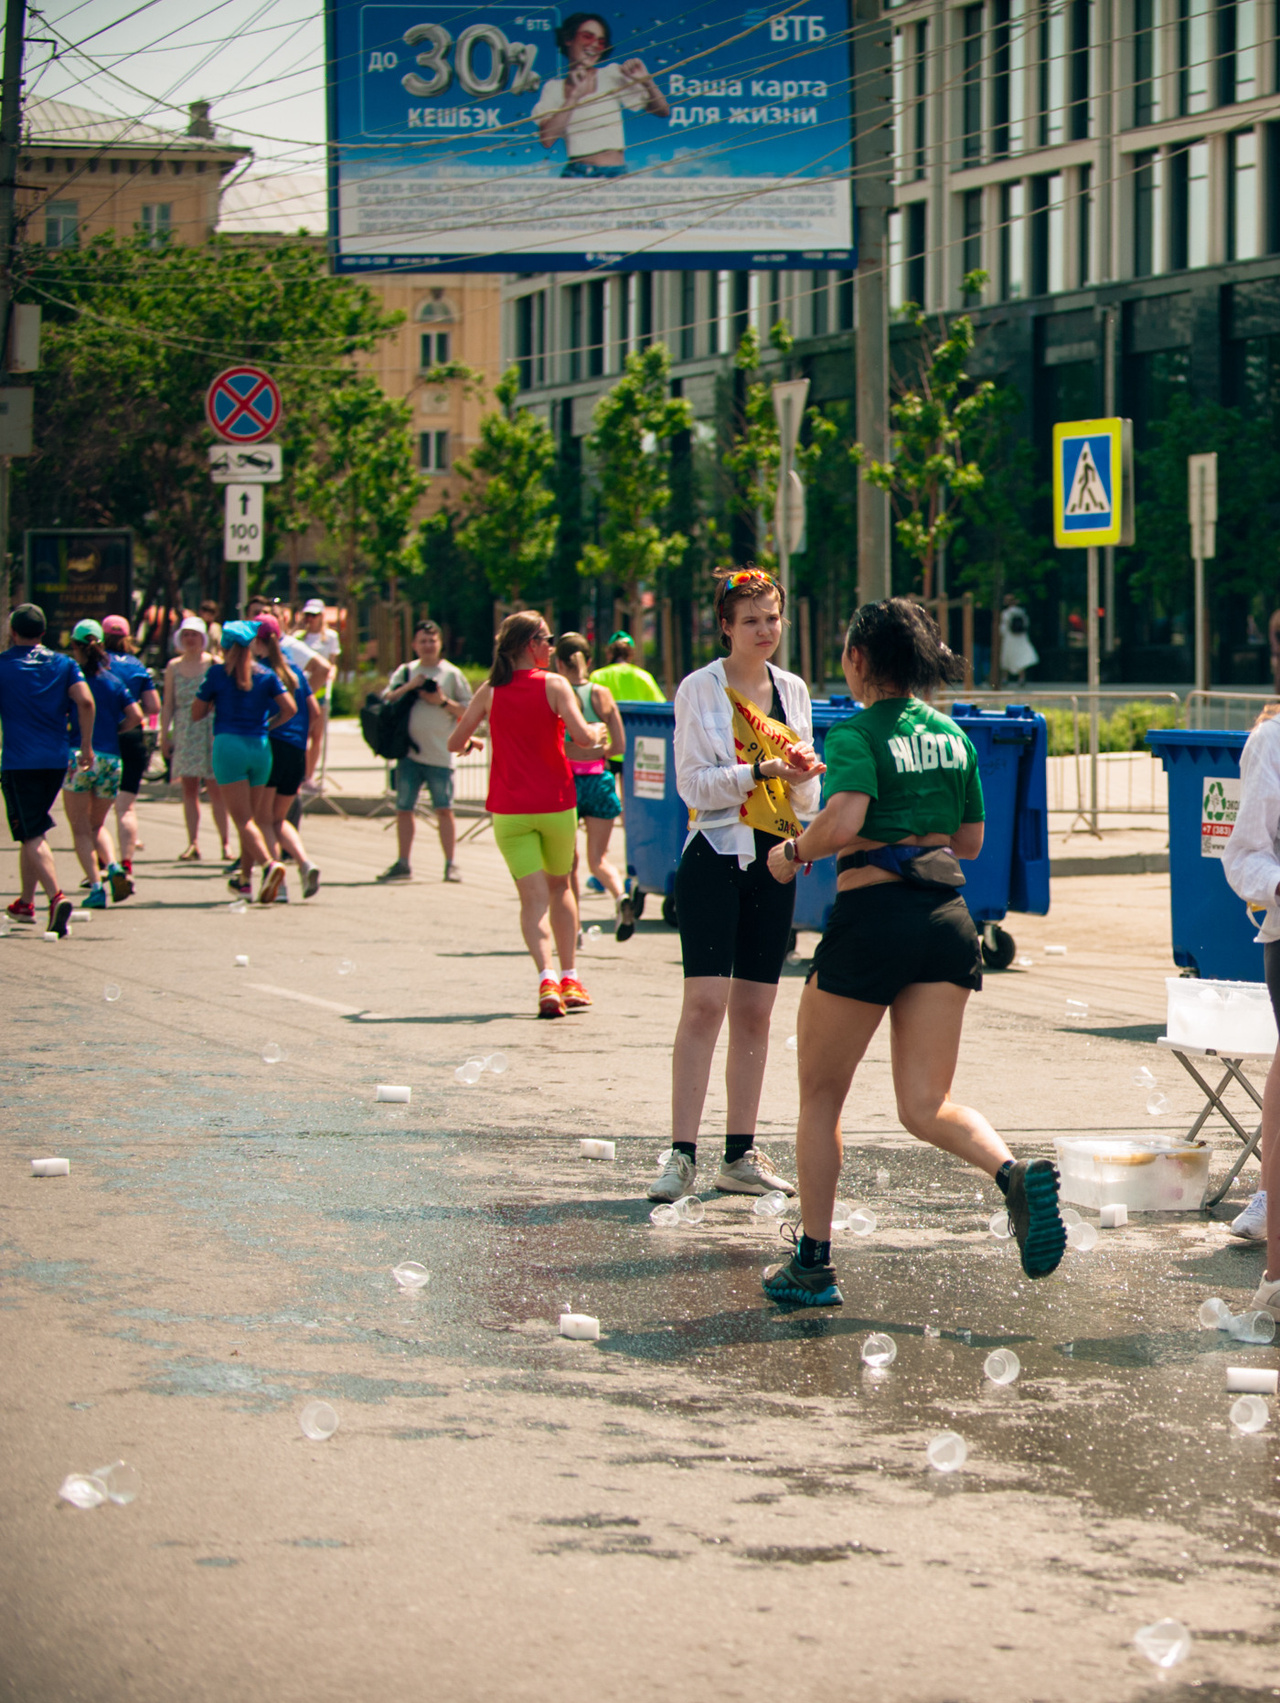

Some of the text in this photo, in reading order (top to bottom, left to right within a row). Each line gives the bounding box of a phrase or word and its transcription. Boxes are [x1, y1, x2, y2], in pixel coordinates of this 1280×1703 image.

[526, 18, 552, 31] ВТБ
[770, 15, 827, 42] ВТБ
[669, 74, 828, 103] Ваша карта
[408, 107, 502, 129] КЕШБЭК
[668, 106, 818, 128] для жизни
[230, 523, 259, 540] 100
[734, 701, 792, 752] ВОЛОНТ
[888, 733, 968, 774] НЦВСМ
